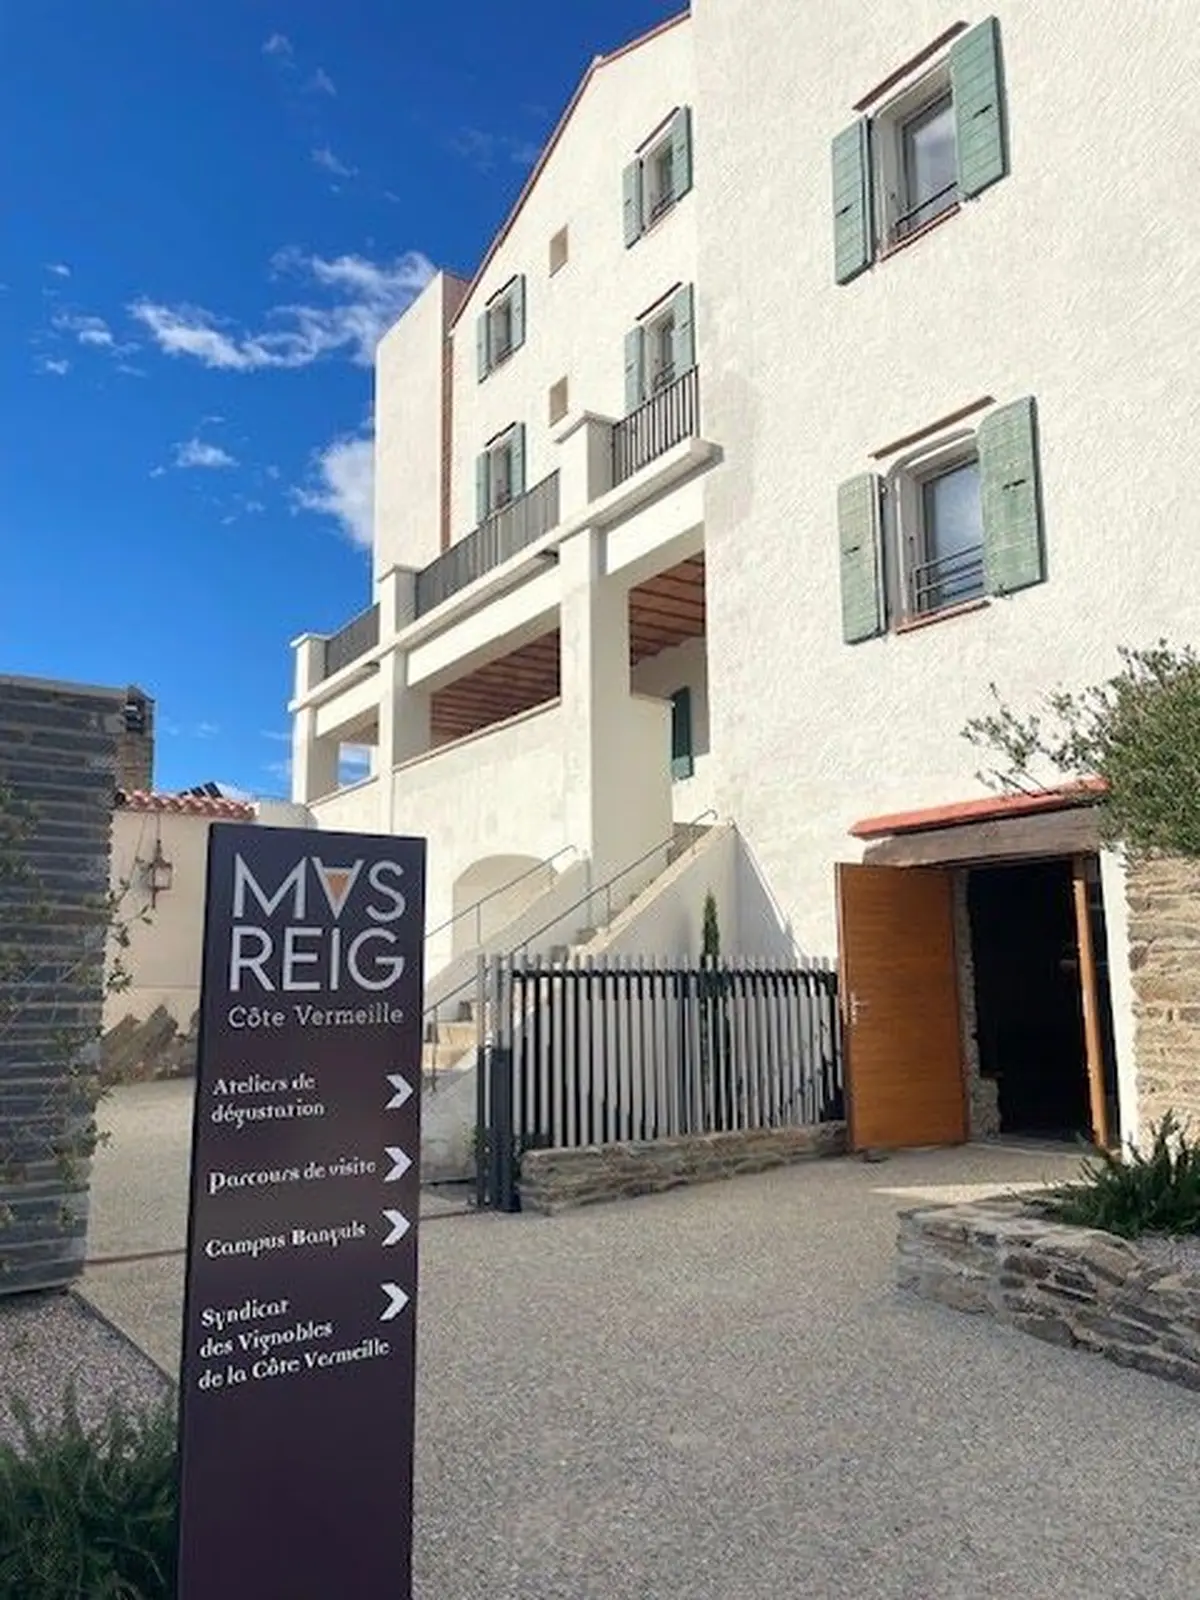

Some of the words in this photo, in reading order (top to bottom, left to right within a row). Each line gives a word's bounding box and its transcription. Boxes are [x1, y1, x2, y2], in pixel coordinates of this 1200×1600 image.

[231, 852, 406, 922] MAS
[229, 925, 405, 992] REIG
[228, 1004, 286, 1028] Côte
[294, 1003, 404, 1026] Vermeille
[212, 1074, 288, 1096] Ateliers
[292, 1073, 316, 1091] de
[211, 1099, 325, 1129] dégustation
[208, 1167, 300, 1194] Parcours
[304, 1162, 326, 1180] de
[329, 1157, 377, 1177] visite
[205, 1234, 286, 1258] Campus
[292, 1221, 366, 1248] Banyuls
[201, 1300, 289, 1331] Syndicat
[200, 1338, 234, 1358] des
[238, 1321, 333, 1355] Vignobles
[199, 1369, 223, 1390] de
[227, 1365, 248, 1385] la
[252, 1357, 300, 1380] Côte
[304, 1337, 390, 1369] Vermeille
